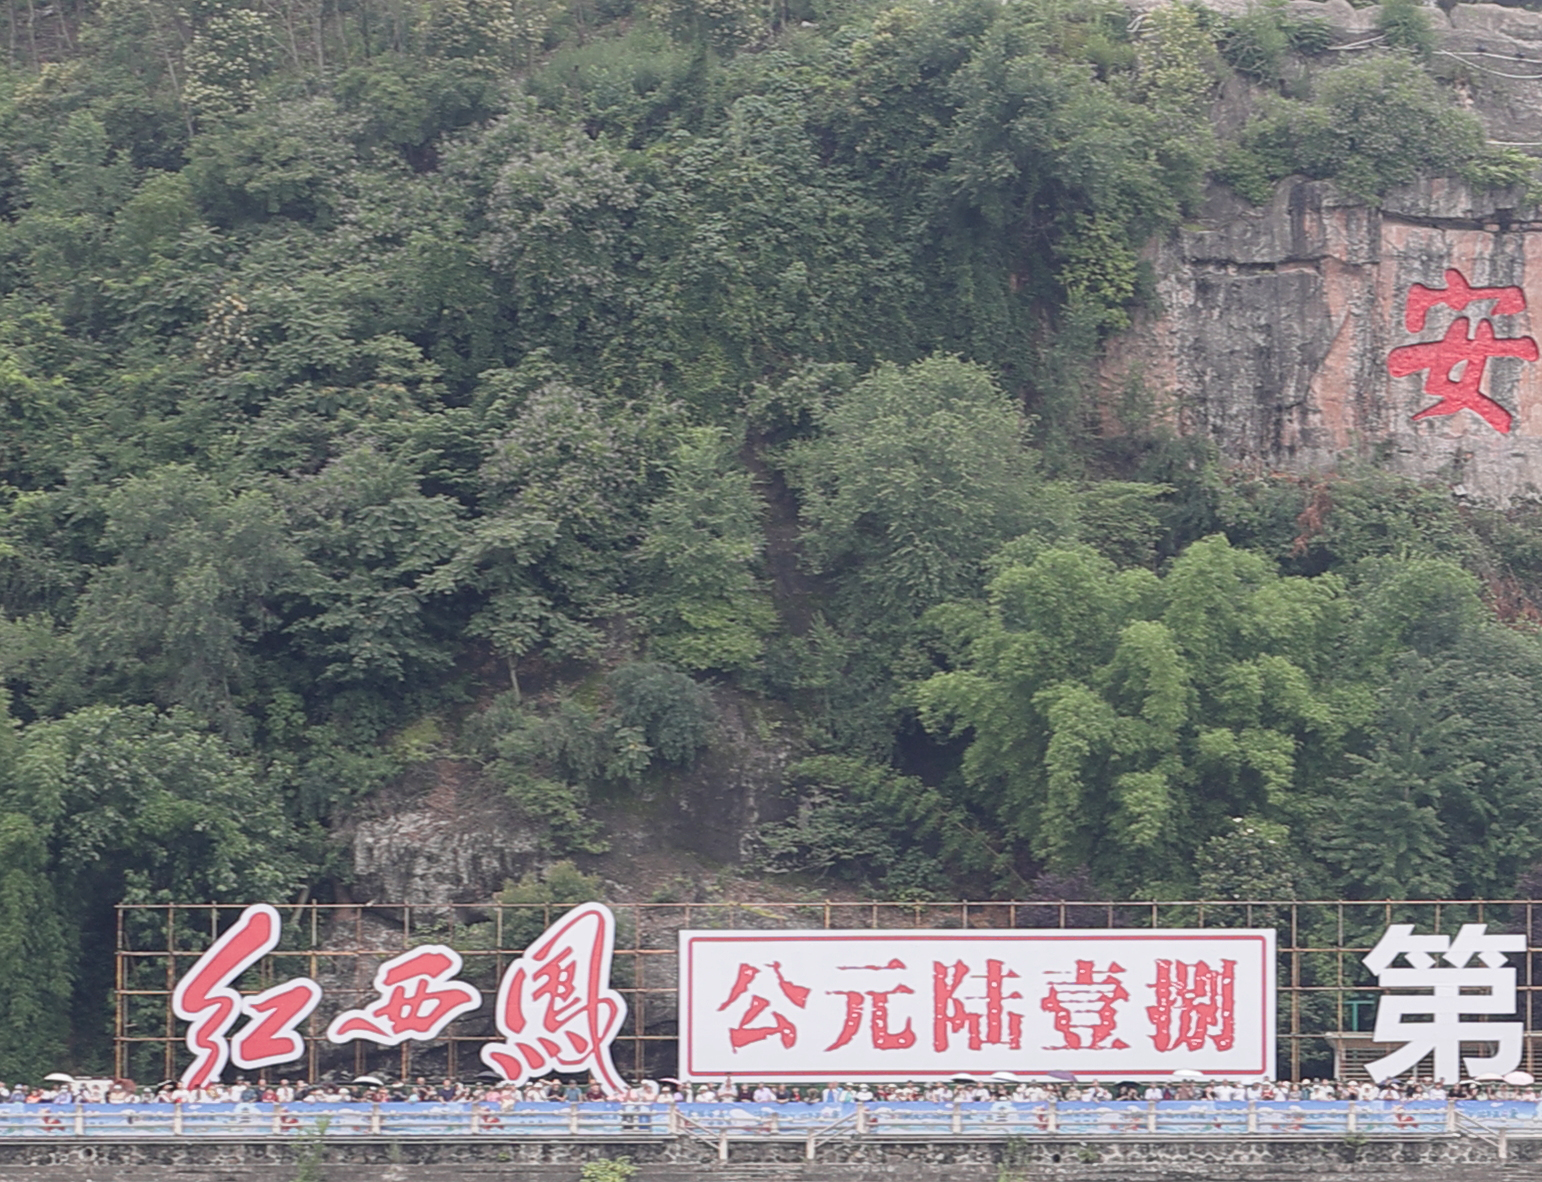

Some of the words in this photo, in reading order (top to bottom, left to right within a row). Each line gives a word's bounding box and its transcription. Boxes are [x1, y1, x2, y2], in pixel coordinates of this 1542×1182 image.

[717, 957, 1237, 1055] 公元陆壹捌
